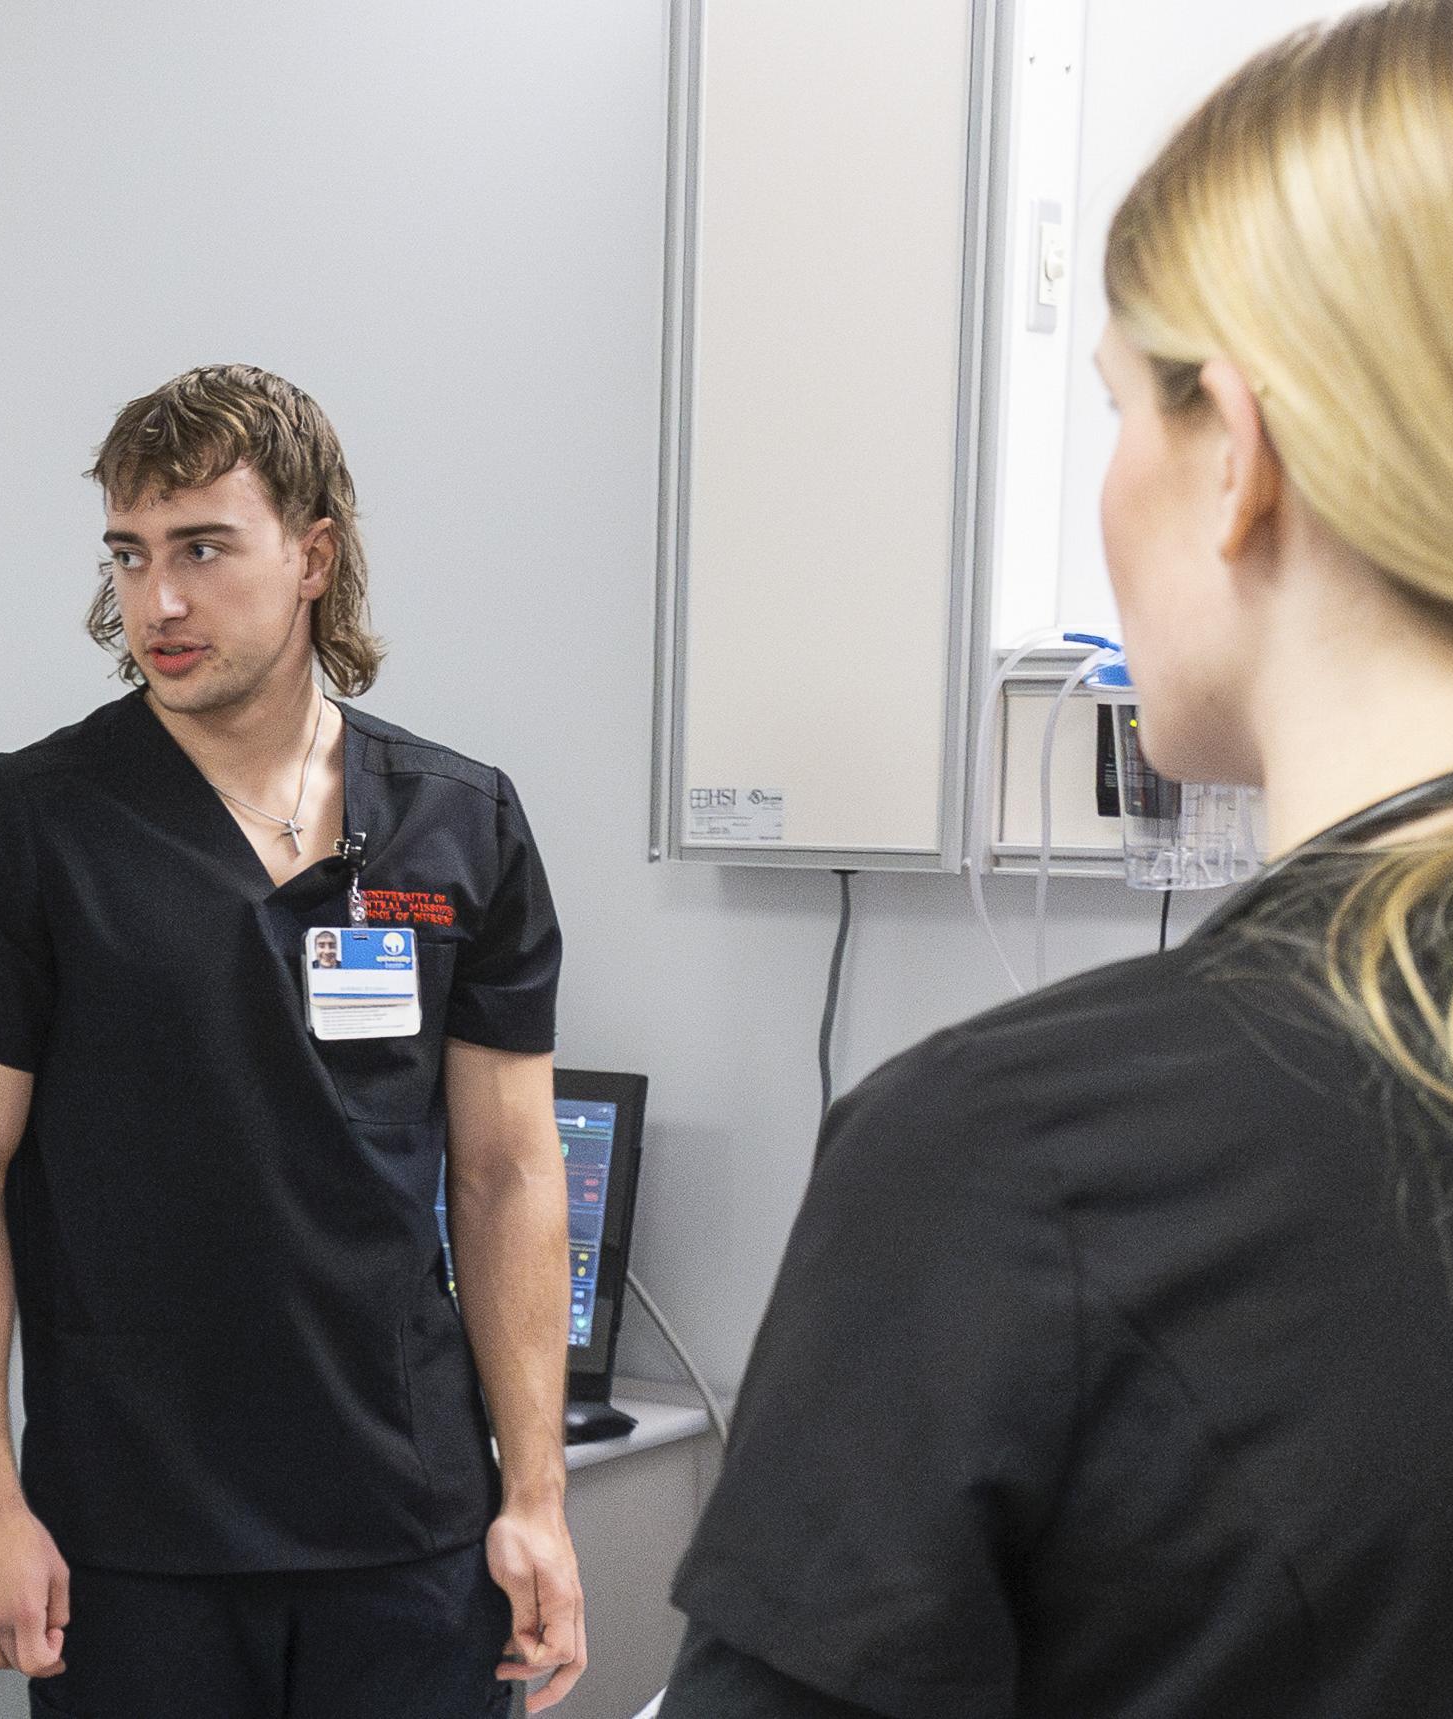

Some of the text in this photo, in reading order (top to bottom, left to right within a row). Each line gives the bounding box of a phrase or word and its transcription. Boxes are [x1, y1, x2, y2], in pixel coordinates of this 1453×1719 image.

[709, 788, 737, 806] HSI
[363, 900, 402, 912] NTRAL
[364, 910, 391, 921] HOOL
[395, 911, 410, 921] OF
